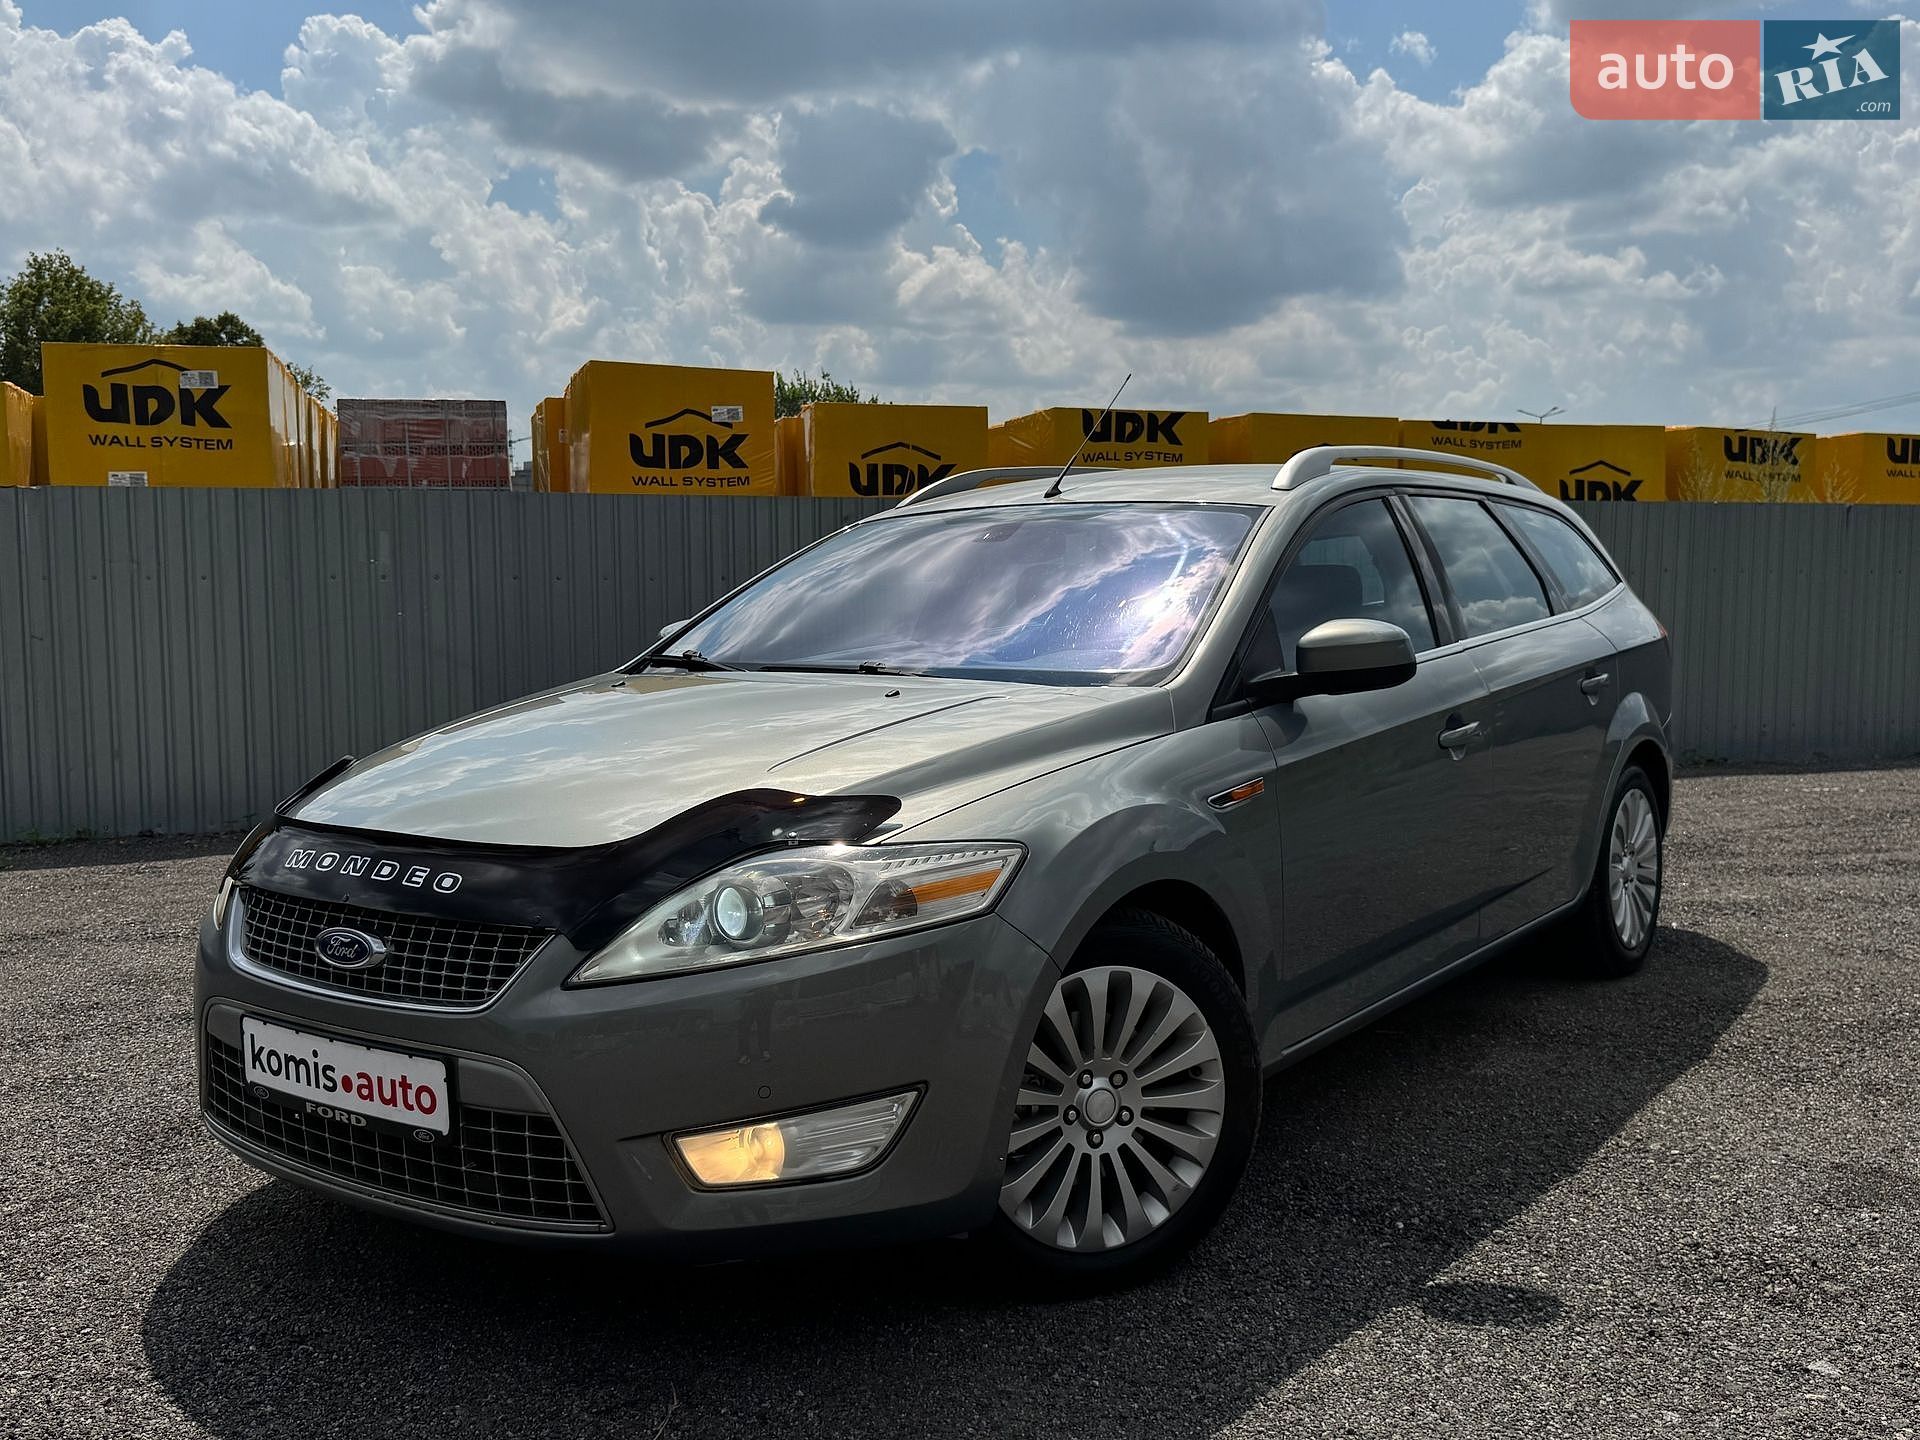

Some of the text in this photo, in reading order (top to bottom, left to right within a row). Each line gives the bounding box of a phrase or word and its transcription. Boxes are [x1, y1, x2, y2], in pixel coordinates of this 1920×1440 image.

[82, 383, 232, 429] UDK
[1081, 408, 1187, 446] UDK
[88, 434, 233, 451] WALL SYSTEM
[629, 433, 750, 470] UDK
[1430, 436, 1522, 450] WALL SYSTEM
[1081, 451, 1183, 463] WALL SYSTEM
[631, 476, 750, 488] WALL SYSTEM
[1886, 469, 1916, 478] WALL
[285, 849, 462, 894] MONDEO
[326, 935, 359, 959] Ford
[306, 1101, 367, 1127] FORD
